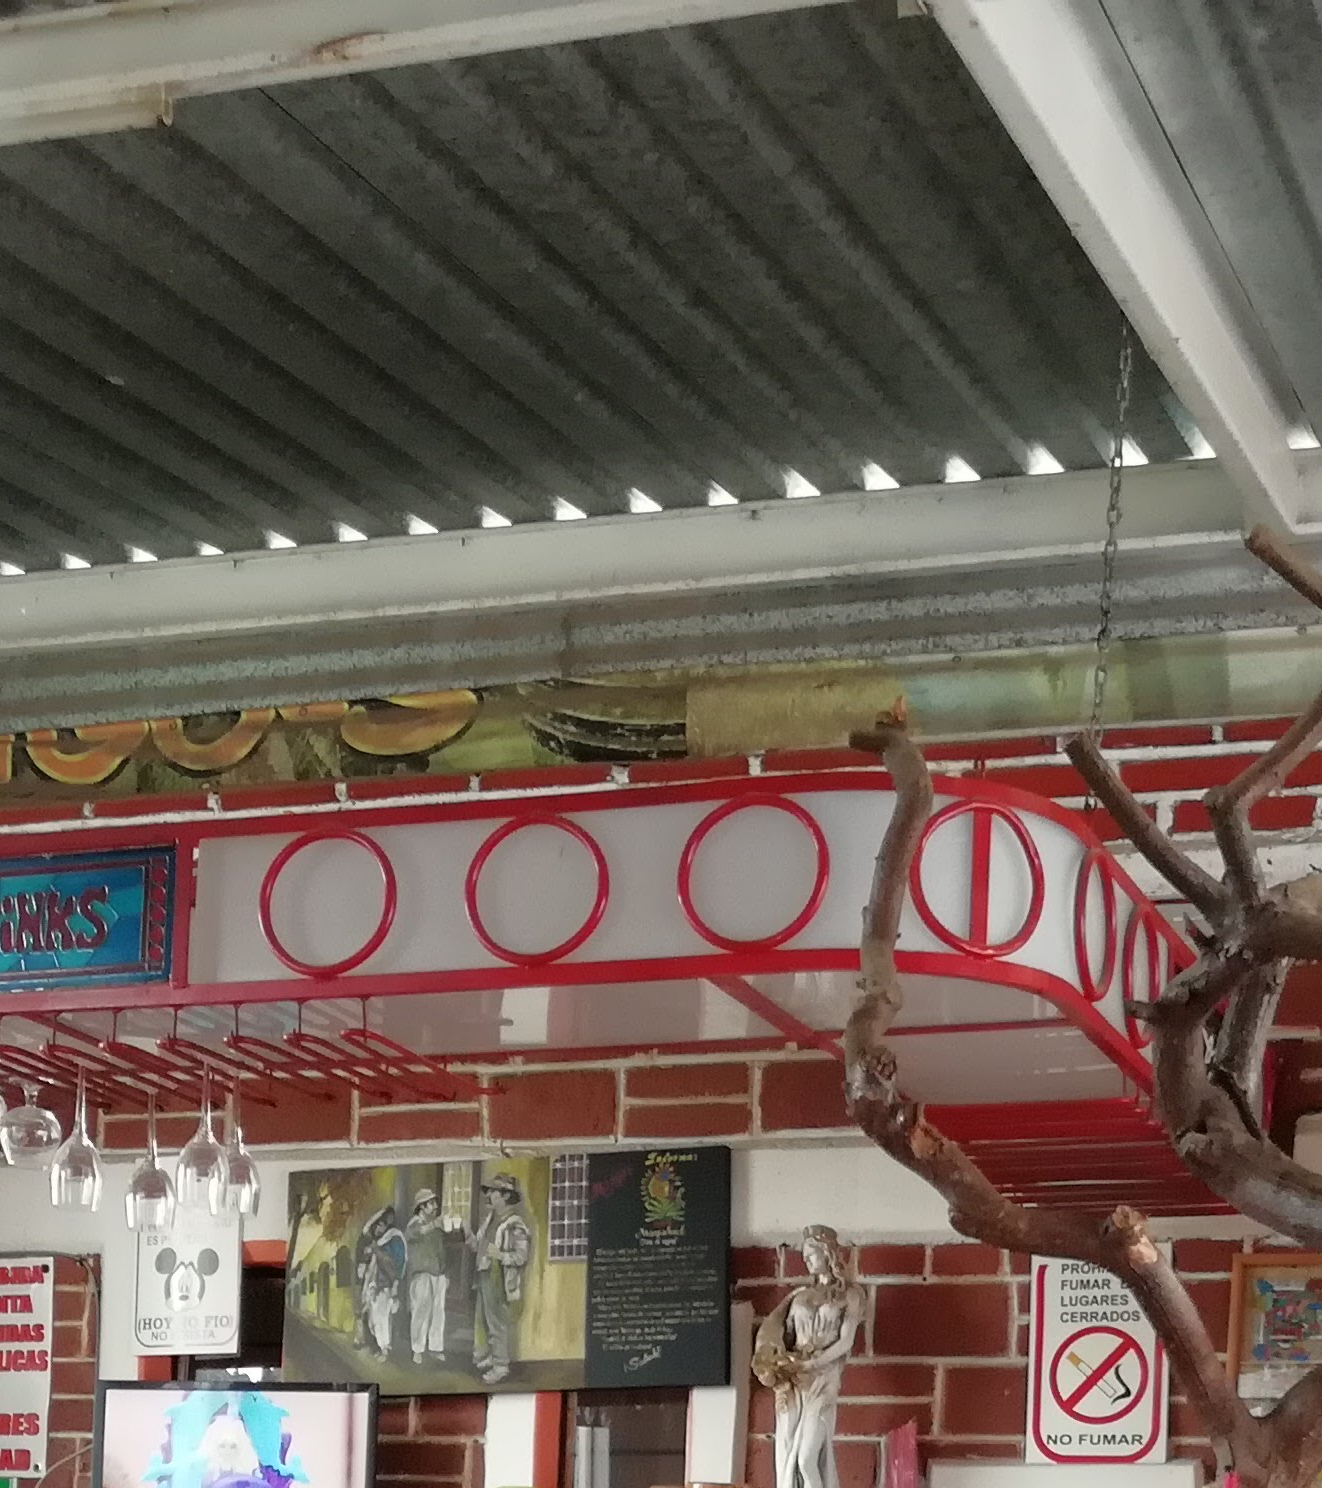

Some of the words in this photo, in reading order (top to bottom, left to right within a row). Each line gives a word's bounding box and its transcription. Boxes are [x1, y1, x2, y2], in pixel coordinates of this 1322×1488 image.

[1061, 1279, 1111, 1290] FUMAR
[1061, 1294, 1129, 1307] LUGARES
[1060, 1311, 1140, 1323] CERRADOS
[151, 1331, 168, 1341] NO
[1046, 1434, 1072, 1446] NO
[1078, 1434, 1143, 1446] FUMAR
